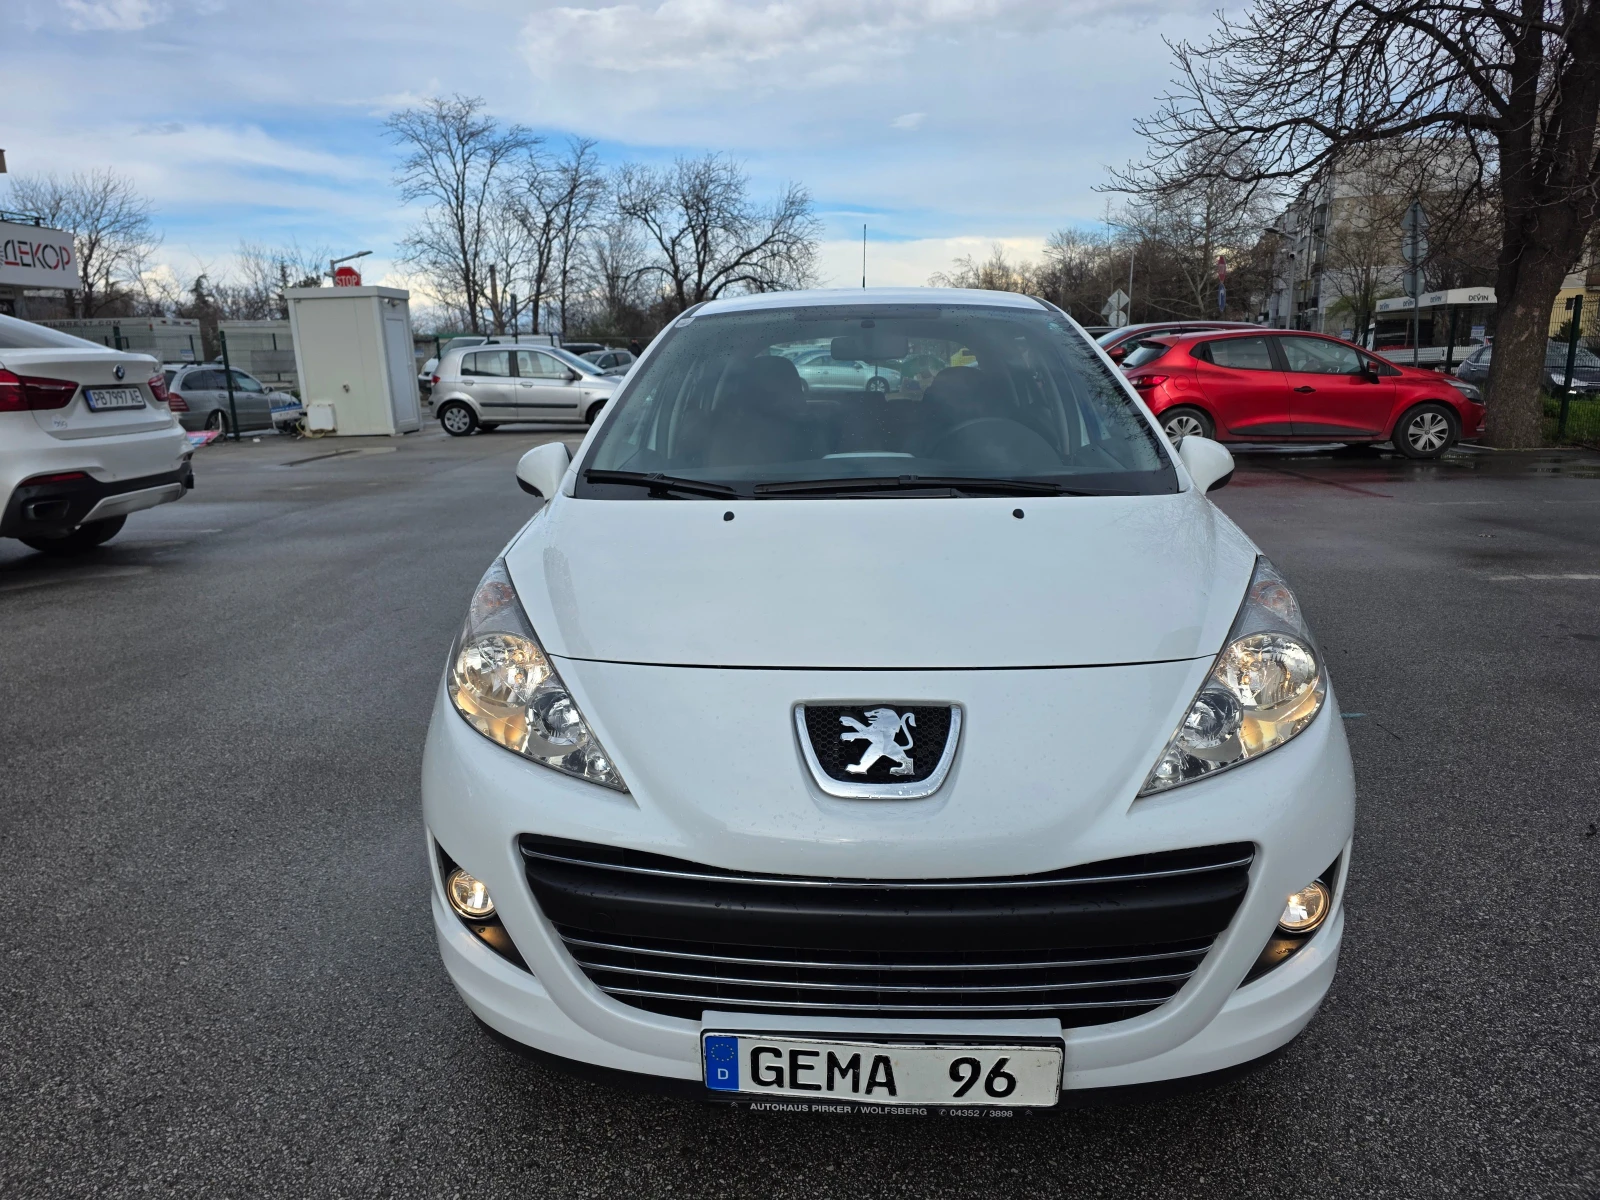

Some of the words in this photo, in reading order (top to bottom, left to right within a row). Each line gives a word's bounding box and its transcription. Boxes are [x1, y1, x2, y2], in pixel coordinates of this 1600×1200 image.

[4, 239, 71, 271] ДЕКОР
[335, 275, 358, 287] STOP
[1468, 293, 1489, 302] DEVIN
[717, 1068, 729, 1080] D
[750, 1045, 898, 1096] GEMA
[948, 1056, 1017, 1098] 96
[749, 1102, 809, 1112] AUTOHAUS
[811, 1104, 851, 1114] PIRKER
[860, 1106, 928, 1116] WOLFSBERG
[950, 1109, 980, 1117] 04352
[989, 1110, 1013, 1118] 3898
